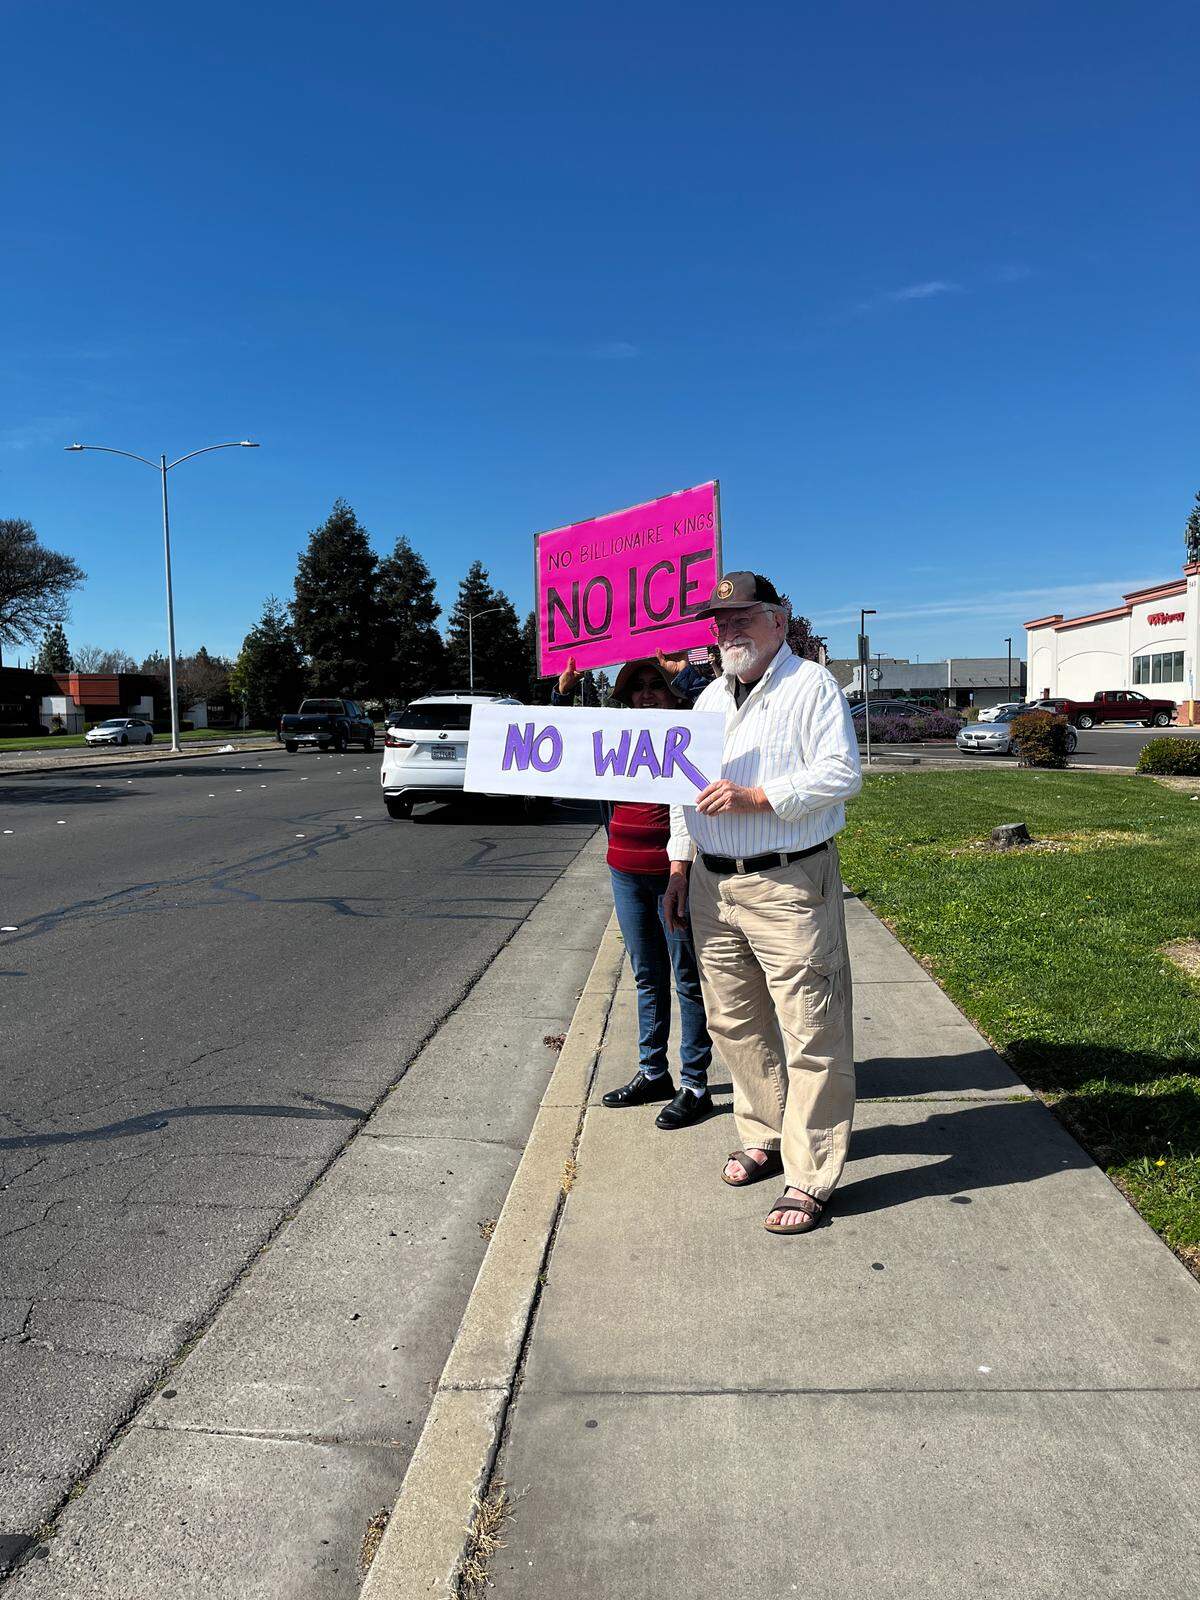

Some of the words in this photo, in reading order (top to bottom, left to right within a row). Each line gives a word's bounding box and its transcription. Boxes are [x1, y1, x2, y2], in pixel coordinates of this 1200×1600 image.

[548, 550, 572, 571] NO
[580, 525, 664, 563] BILLIONAIRE
[673, 511, 714, 539] KINGS
[547, 575, 614, 643] NO
[629, 548, 713, 628] ICE
[501, 722, 563, 773] NO
[592, 726, 711, 792] WAR
